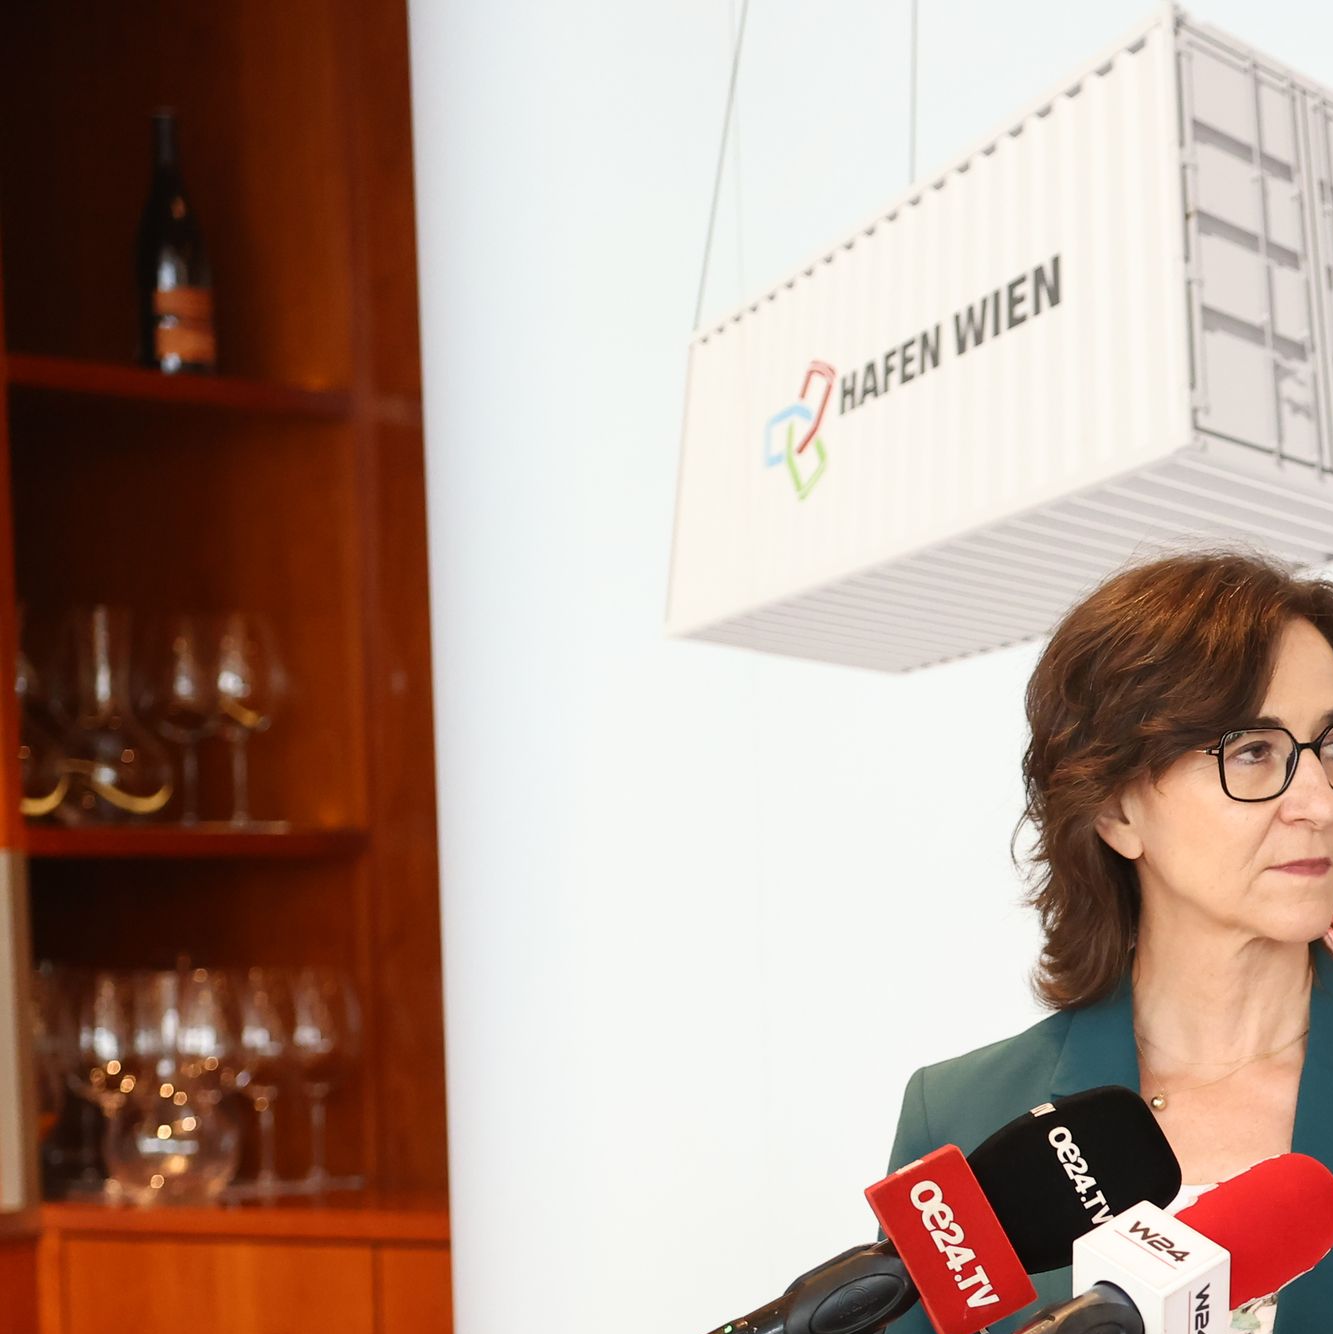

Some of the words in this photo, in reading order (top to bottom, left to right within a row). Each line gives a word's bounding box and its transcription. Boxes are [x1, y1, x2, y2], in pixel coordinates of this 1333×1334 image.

[838, 325, 941, 416] HAFEN
[953, 254, 1062, 358] WIEN
[910, 1180, 1000, 1308] oe24.TV
[1129, 1220, 1191, 1263] W24
